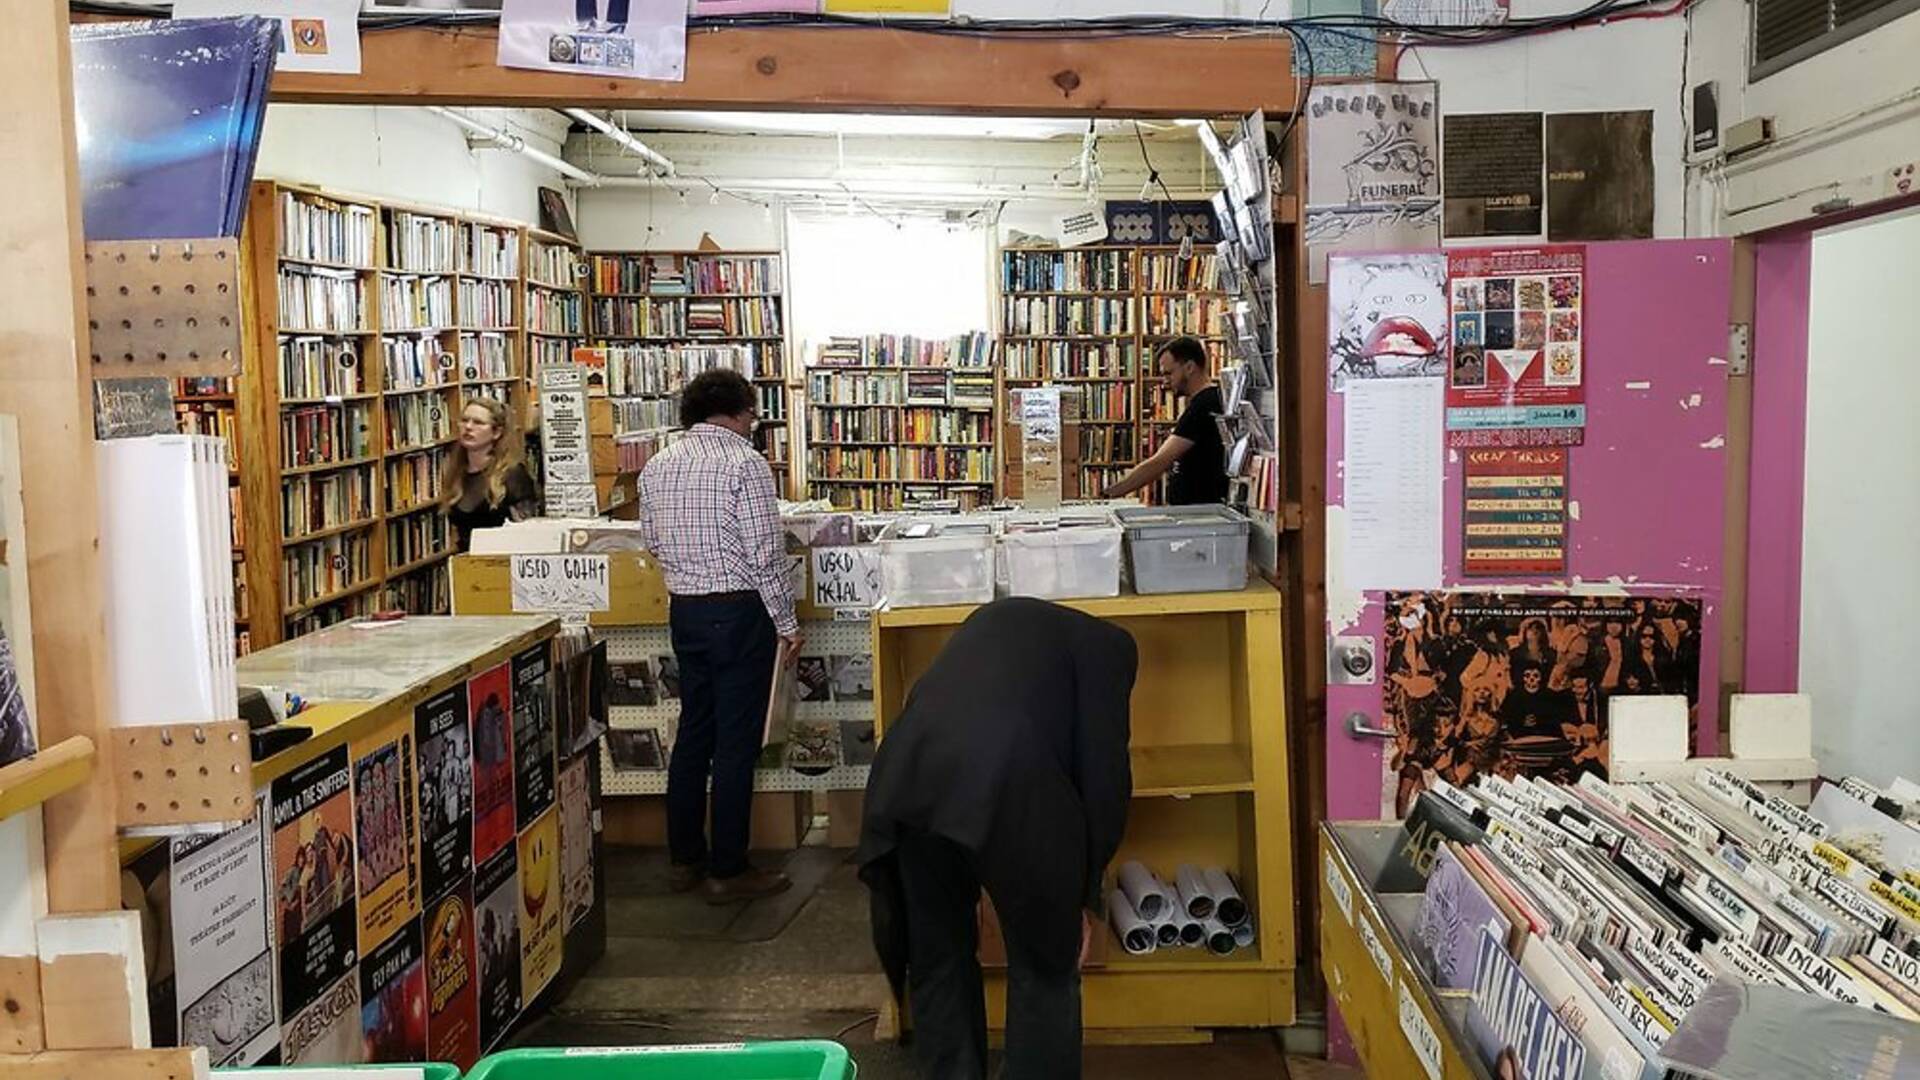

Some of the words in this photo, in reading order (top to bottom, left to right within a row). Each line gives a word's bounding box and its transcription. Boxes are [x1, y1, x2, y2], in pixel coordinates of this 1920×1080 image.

[1361, 183, 1425, 198] FUNERAL
[518, 558, 550, 579] USED
[564, 557, 597, 580] GOTH
[819, 551, 853, 573] USED
[817, 581, 861, 603] METAL
[302, 784, 316, 810] THE
[316, 767, 349, 801] SNIFFERS
[1633, 937, 1679, 983] DINOSAUR
[1473, 928, 1513, 1042] LANA
